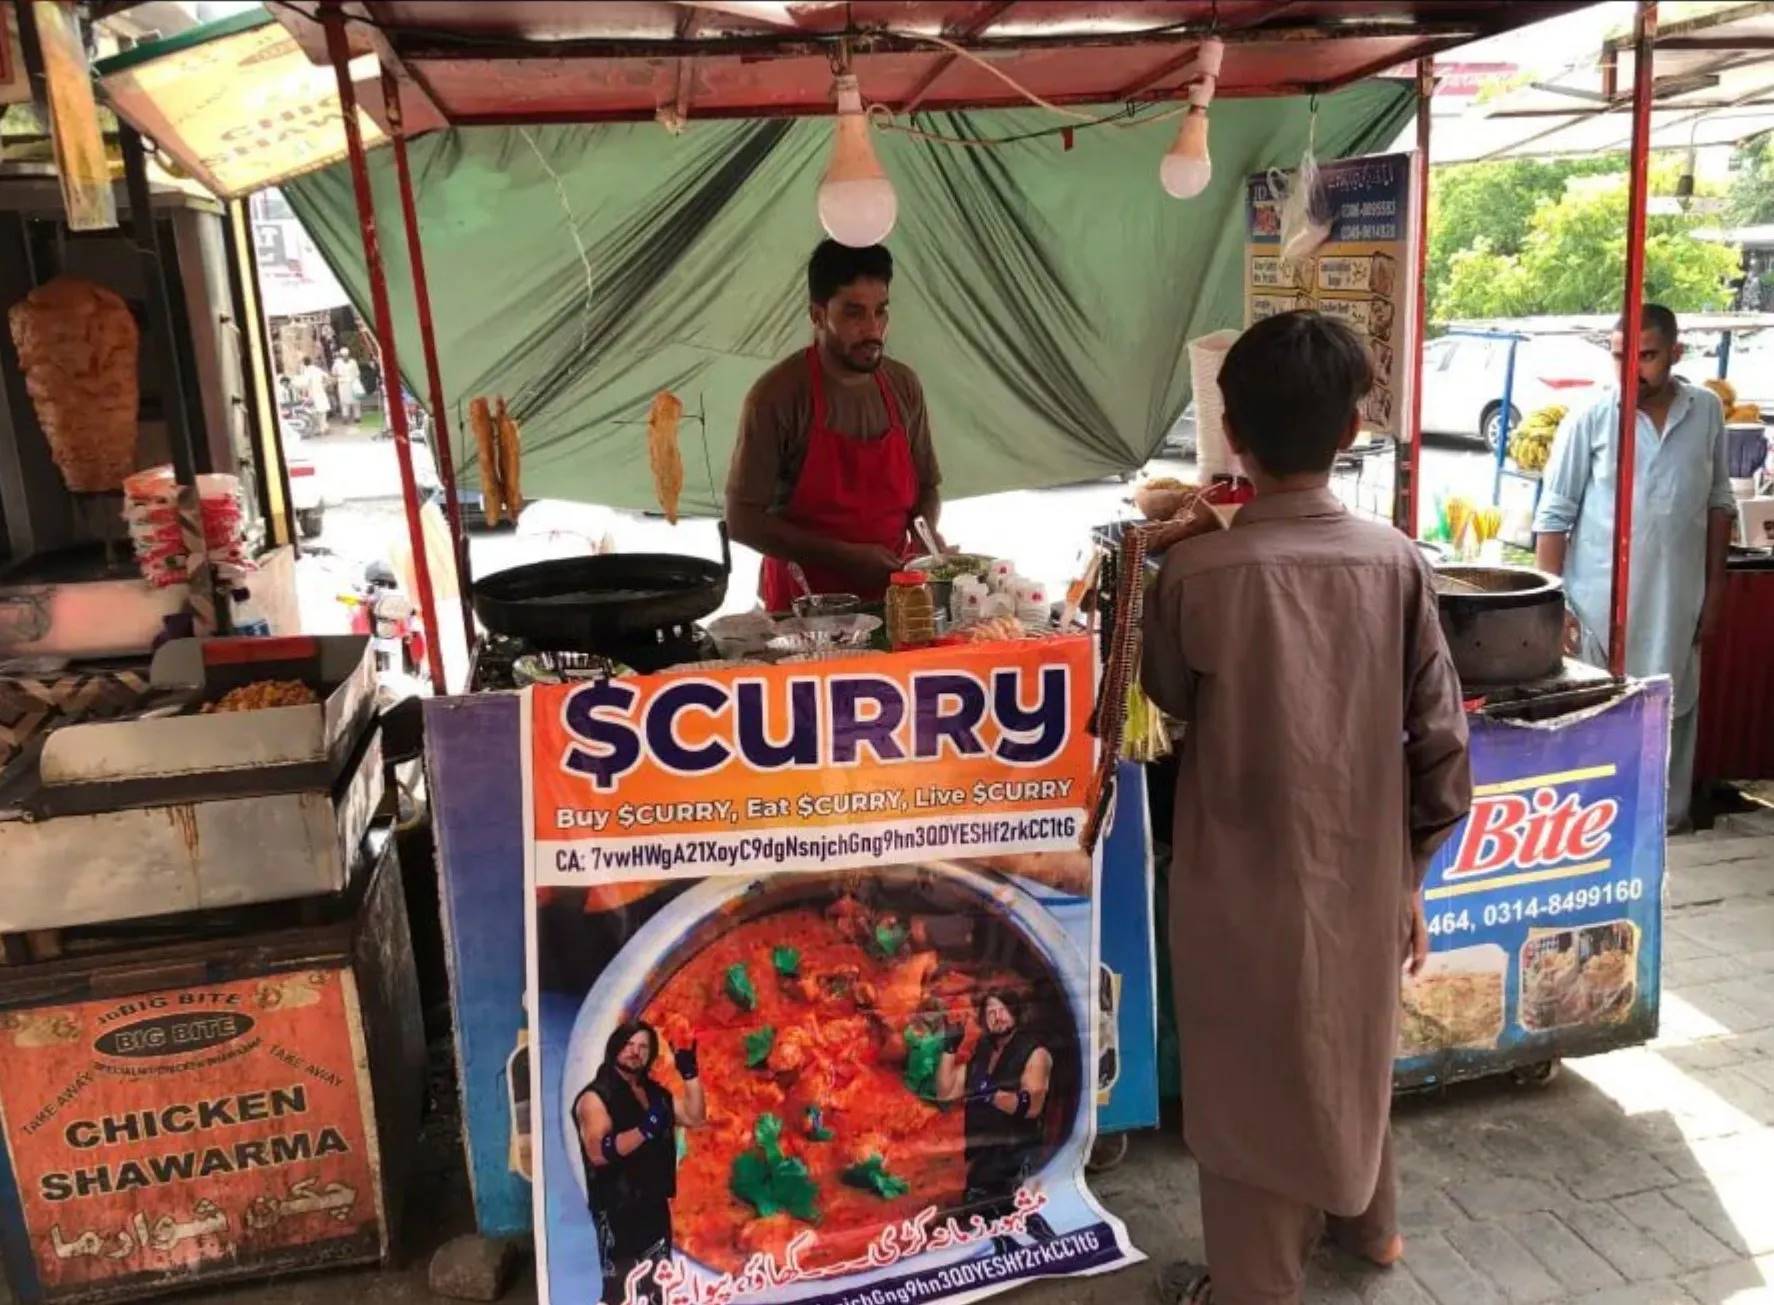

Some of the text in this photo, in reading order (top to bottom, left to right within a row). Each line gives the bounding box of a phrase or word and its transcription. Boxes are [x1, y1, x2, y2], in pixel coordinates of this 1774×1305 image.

[562, 664, 1069, 793] $CURRY
[556, 779, 1074, 830] Buy $CURRY, Eat $CURRY, Live $CURRY
[1442, 787, 1618, 881] Bite
[556, 849, 586, 872] CA:
[1427, 878, 1643, 936] 464, 0314-8499160
[115, 1015, 238, 1053] BIG BITE
[65, 1084, 308, 1149] CHICKEN
[40, 1127, 349, 1202] SHAWARMA
